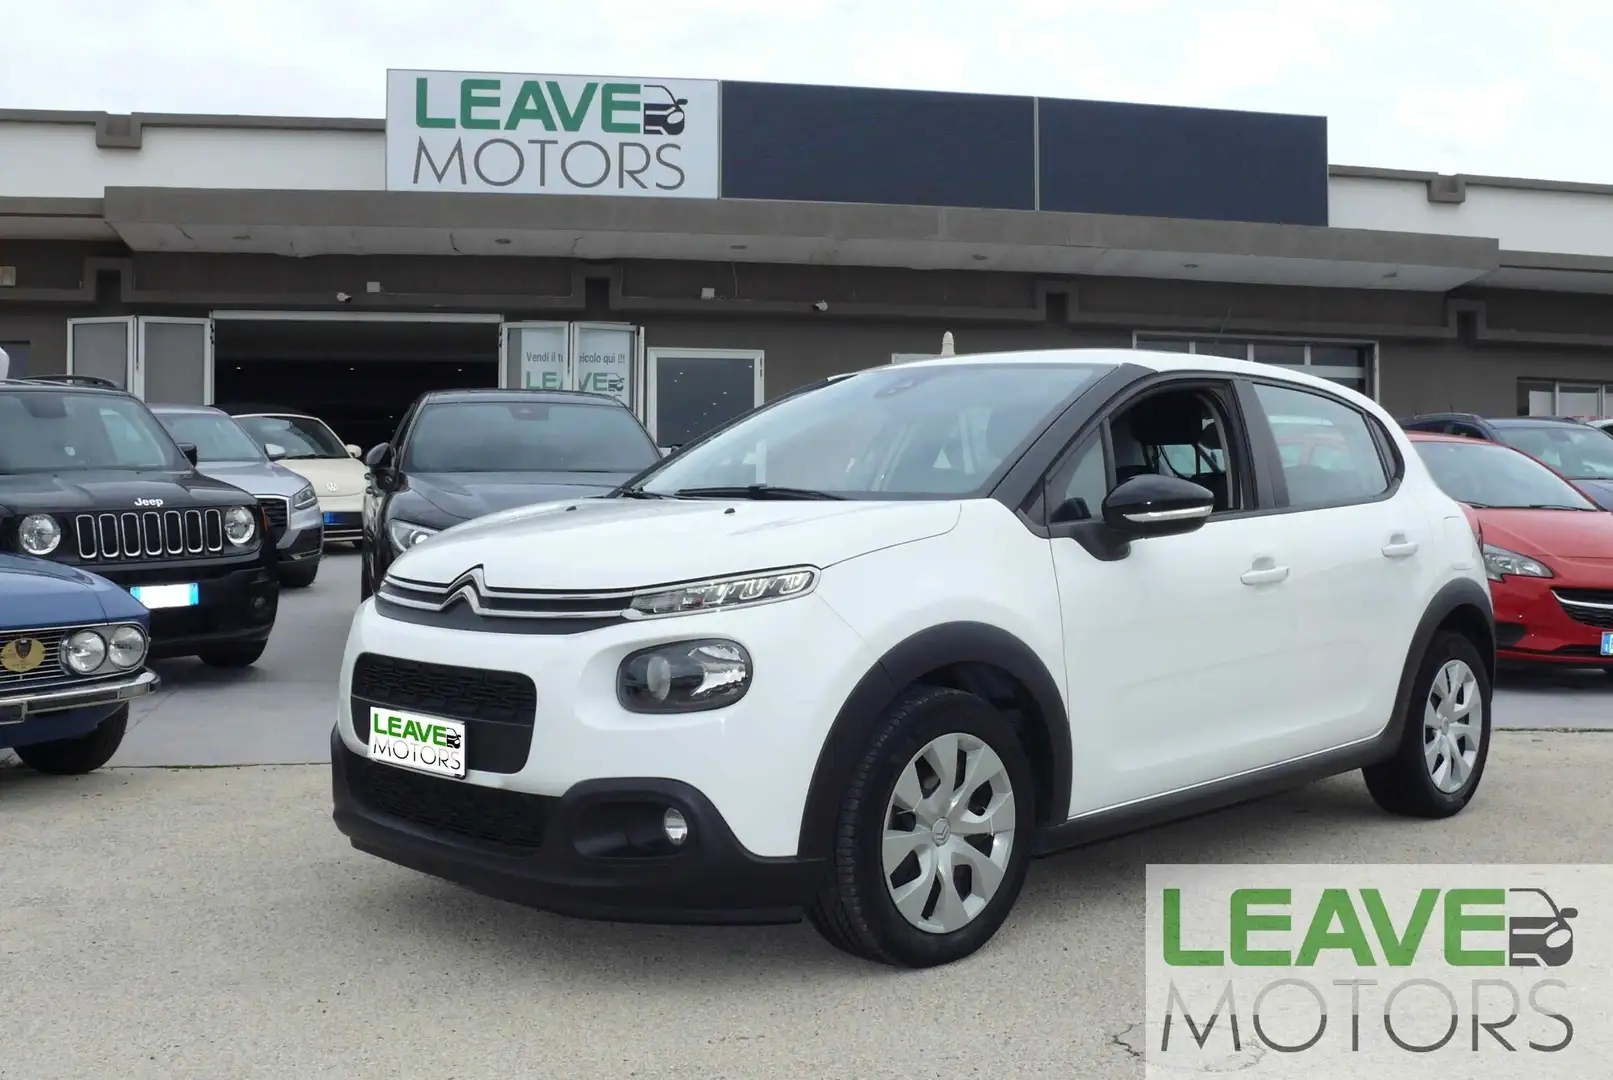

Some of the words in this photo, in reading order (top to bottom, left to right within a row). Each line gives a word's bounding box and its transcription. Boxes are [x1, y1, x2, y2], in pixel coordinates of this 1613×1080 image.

[415, 77, 641, 134] LEAVE
[412, 136, 685, 190] MOTORS
[526, 352, 549, 363] Vendi
[551, 352, 556, 362] il
[603, 353, 616, 365] qui
[526, 371, 607, 391] LEVE
[134, 497, 164, 507] Jeep
[374, 713, 447, 747] LEAVE
[373, 736, 461, 770] MOTORS
